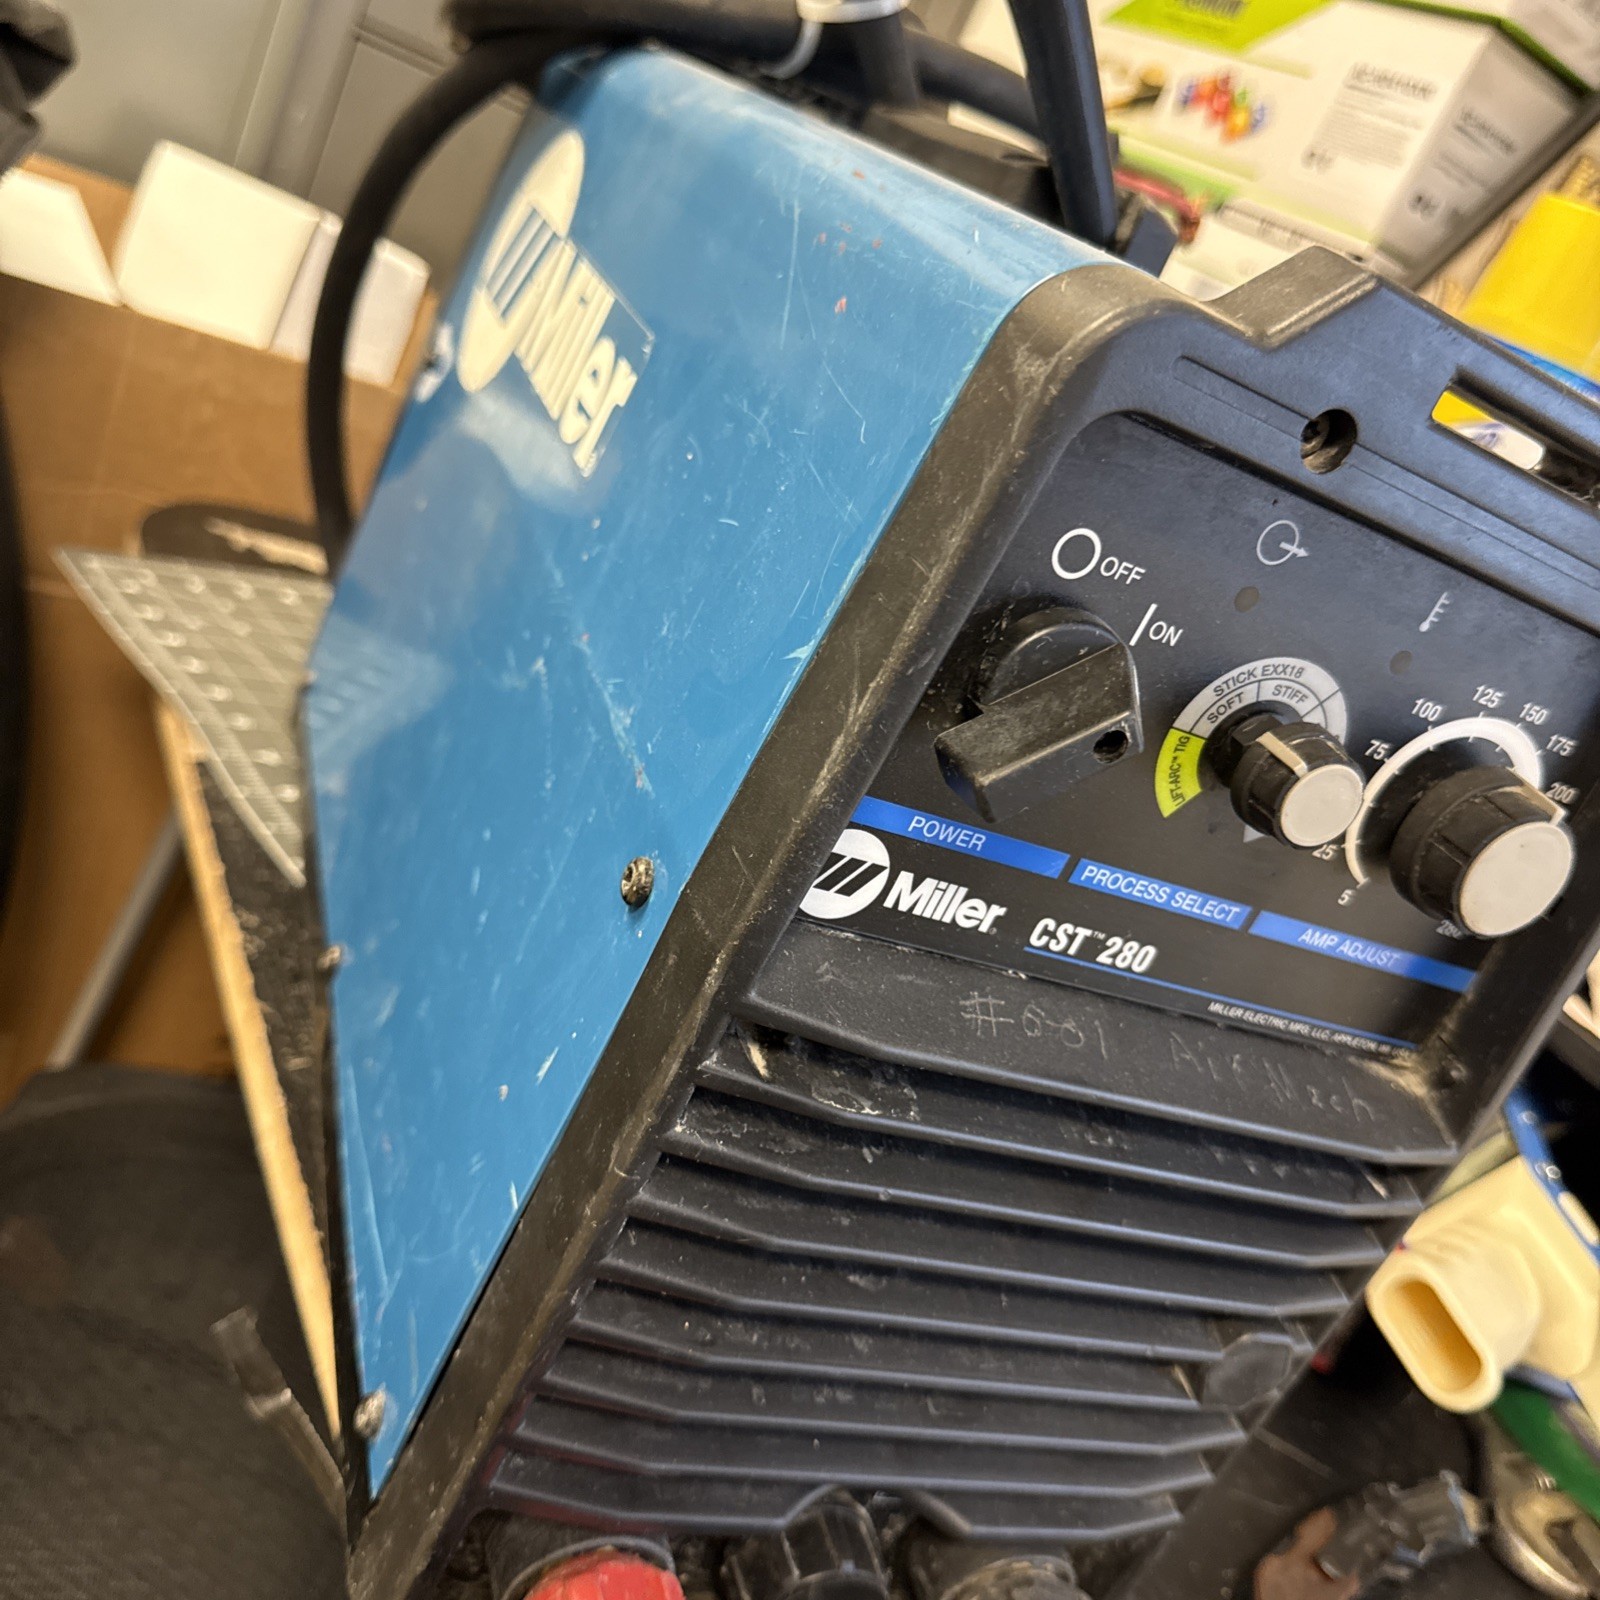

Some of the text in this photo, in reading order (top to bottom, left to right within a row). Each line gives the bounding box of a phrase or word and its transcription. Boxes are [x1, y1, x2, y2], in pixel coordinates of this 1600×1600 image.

[514, 238, 638, 478] Miller
[1100, 556, 1147, 585] OFF
[1148, 620, 1184, 647] ON
[1213, 664, 1305, 697] STICK EXX18
[1272, 684, 1309, 704] STIFF
[1207, 691, 1245, 724] SOFT
[1411, 698, 1443, 722] 100
[1472, 684, 1504, 709] 125
[1518, 702, 1549, 726] 150
[1178, 735, 1191, 754] TIG
[1364, 739, 1389, 760] 75
[1546, 734, 1577, 757] 175
[1545, 781, 1578, 804] 200
[907, 815, 987, 852] POWER
[883, 870, 1008, 934] Miller
[1081, 865, 1240, 924] PROCESS SELECT
[1337, 889, 1355, 906] 5
[1095, 936, 1158, 974] 280
[1298, 928, 1402, 969] AMP ADJUST
[1207, 1001, 1244, 1018] MILLER
[1243, 1009, 1289, 1030] ELECTRIC
